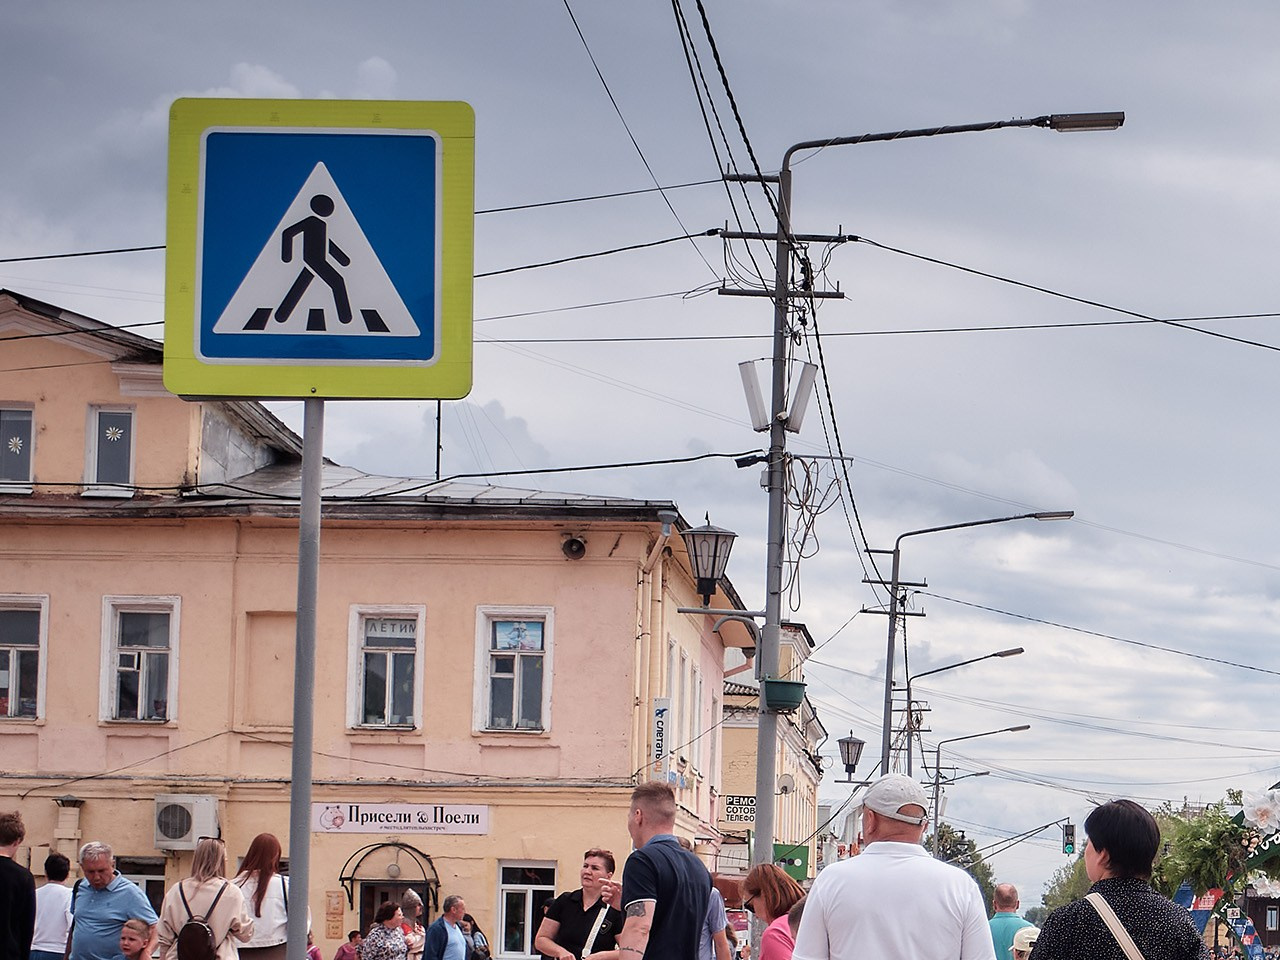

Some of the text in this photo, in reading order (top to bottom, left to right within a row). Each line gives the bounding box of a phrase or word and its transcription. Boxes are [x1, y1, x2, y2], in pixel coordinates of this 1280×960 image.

[654, 719, 665, 773] слетатьру
[348, 804, 412, 825] Присели
[432, 805, 480, 824] Поели
